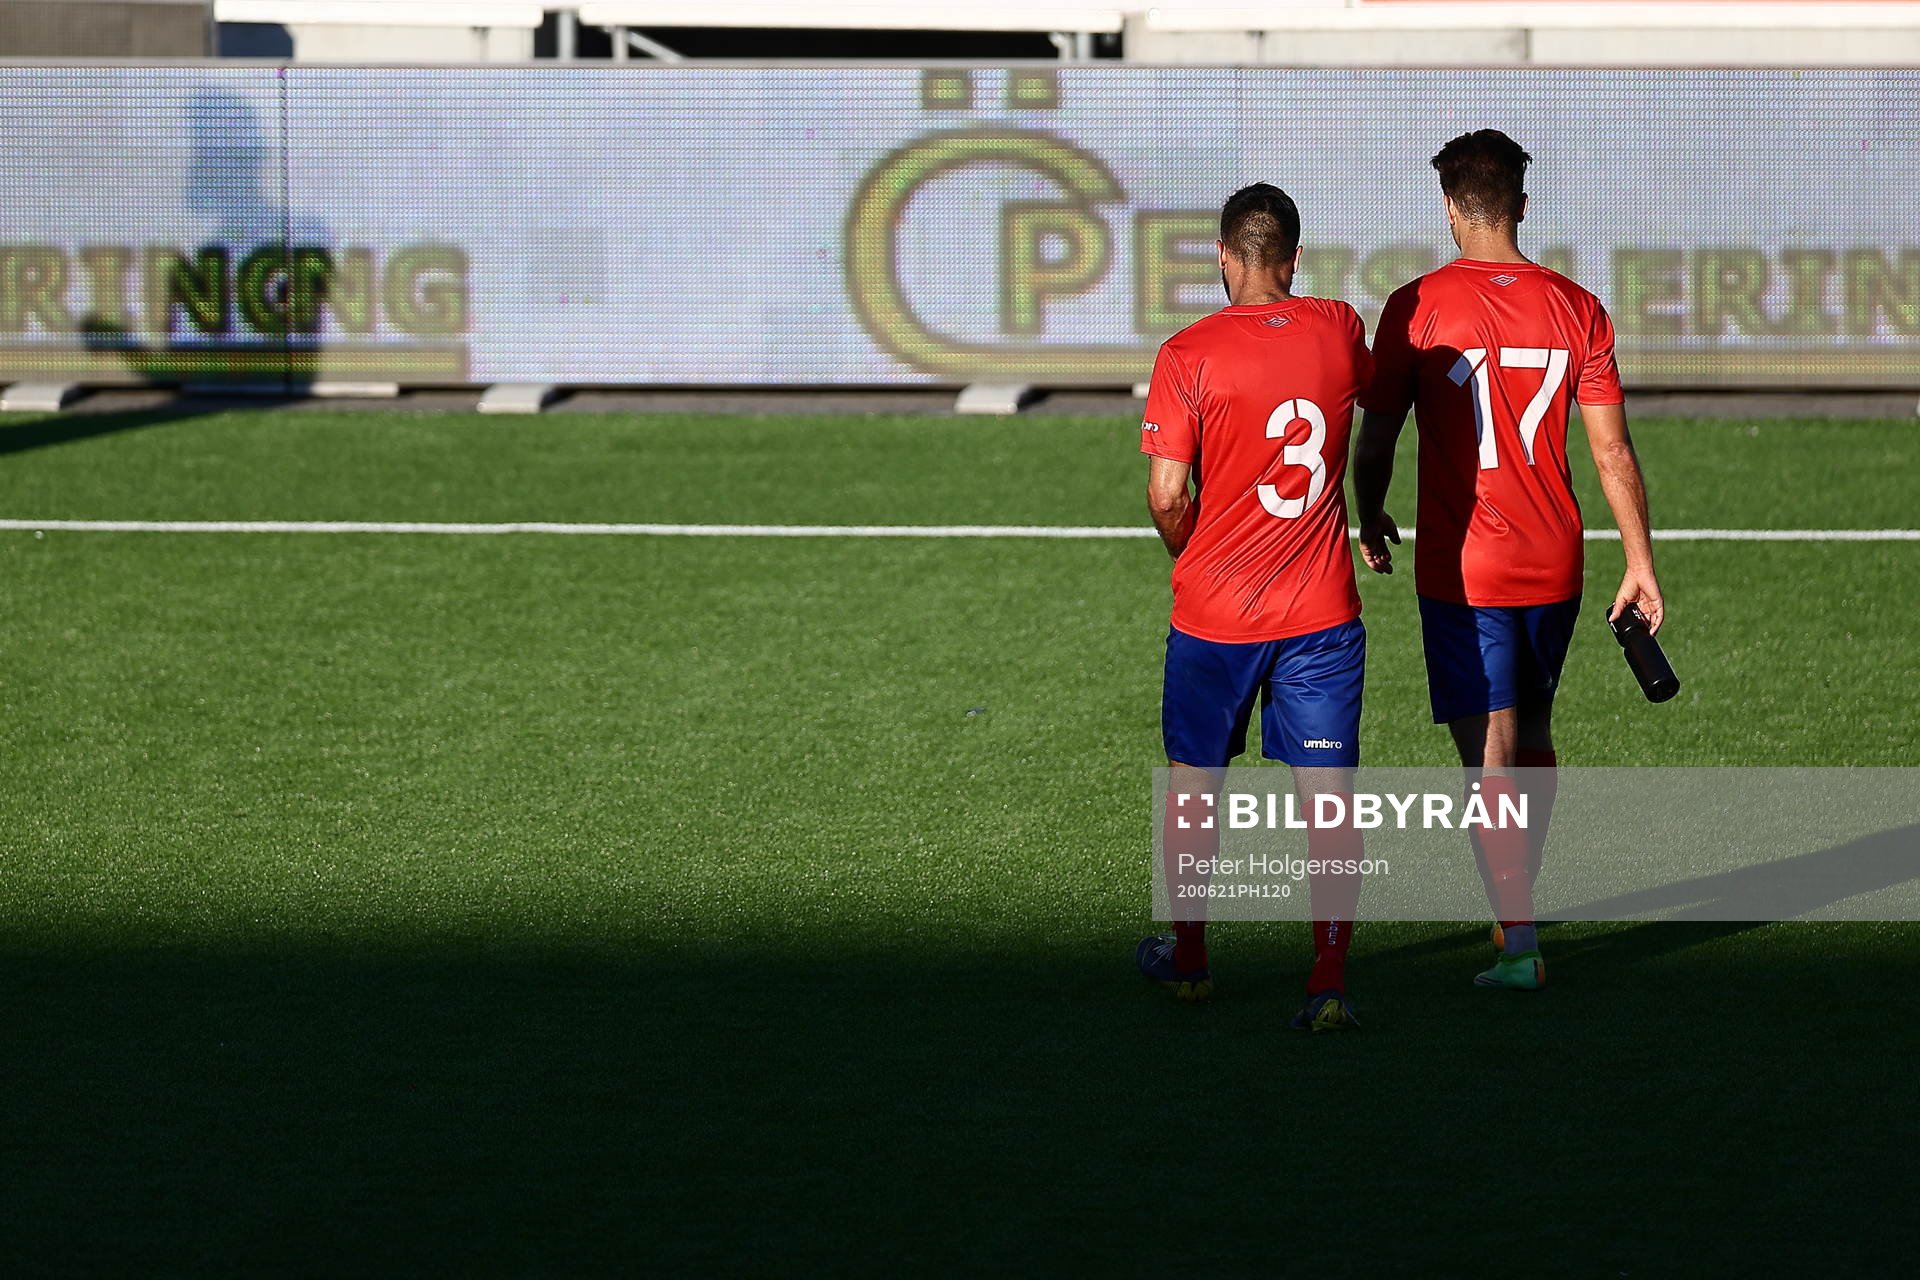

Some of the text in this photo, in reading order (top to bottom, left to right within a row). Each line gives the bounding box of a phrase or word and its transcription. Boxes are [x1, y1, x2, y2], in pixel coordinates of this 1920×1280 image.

[1256, 398, 1328, 519] 3
[1447, 347, 1570, 470] 17
[1303, 738, 1343, 749] umbro
